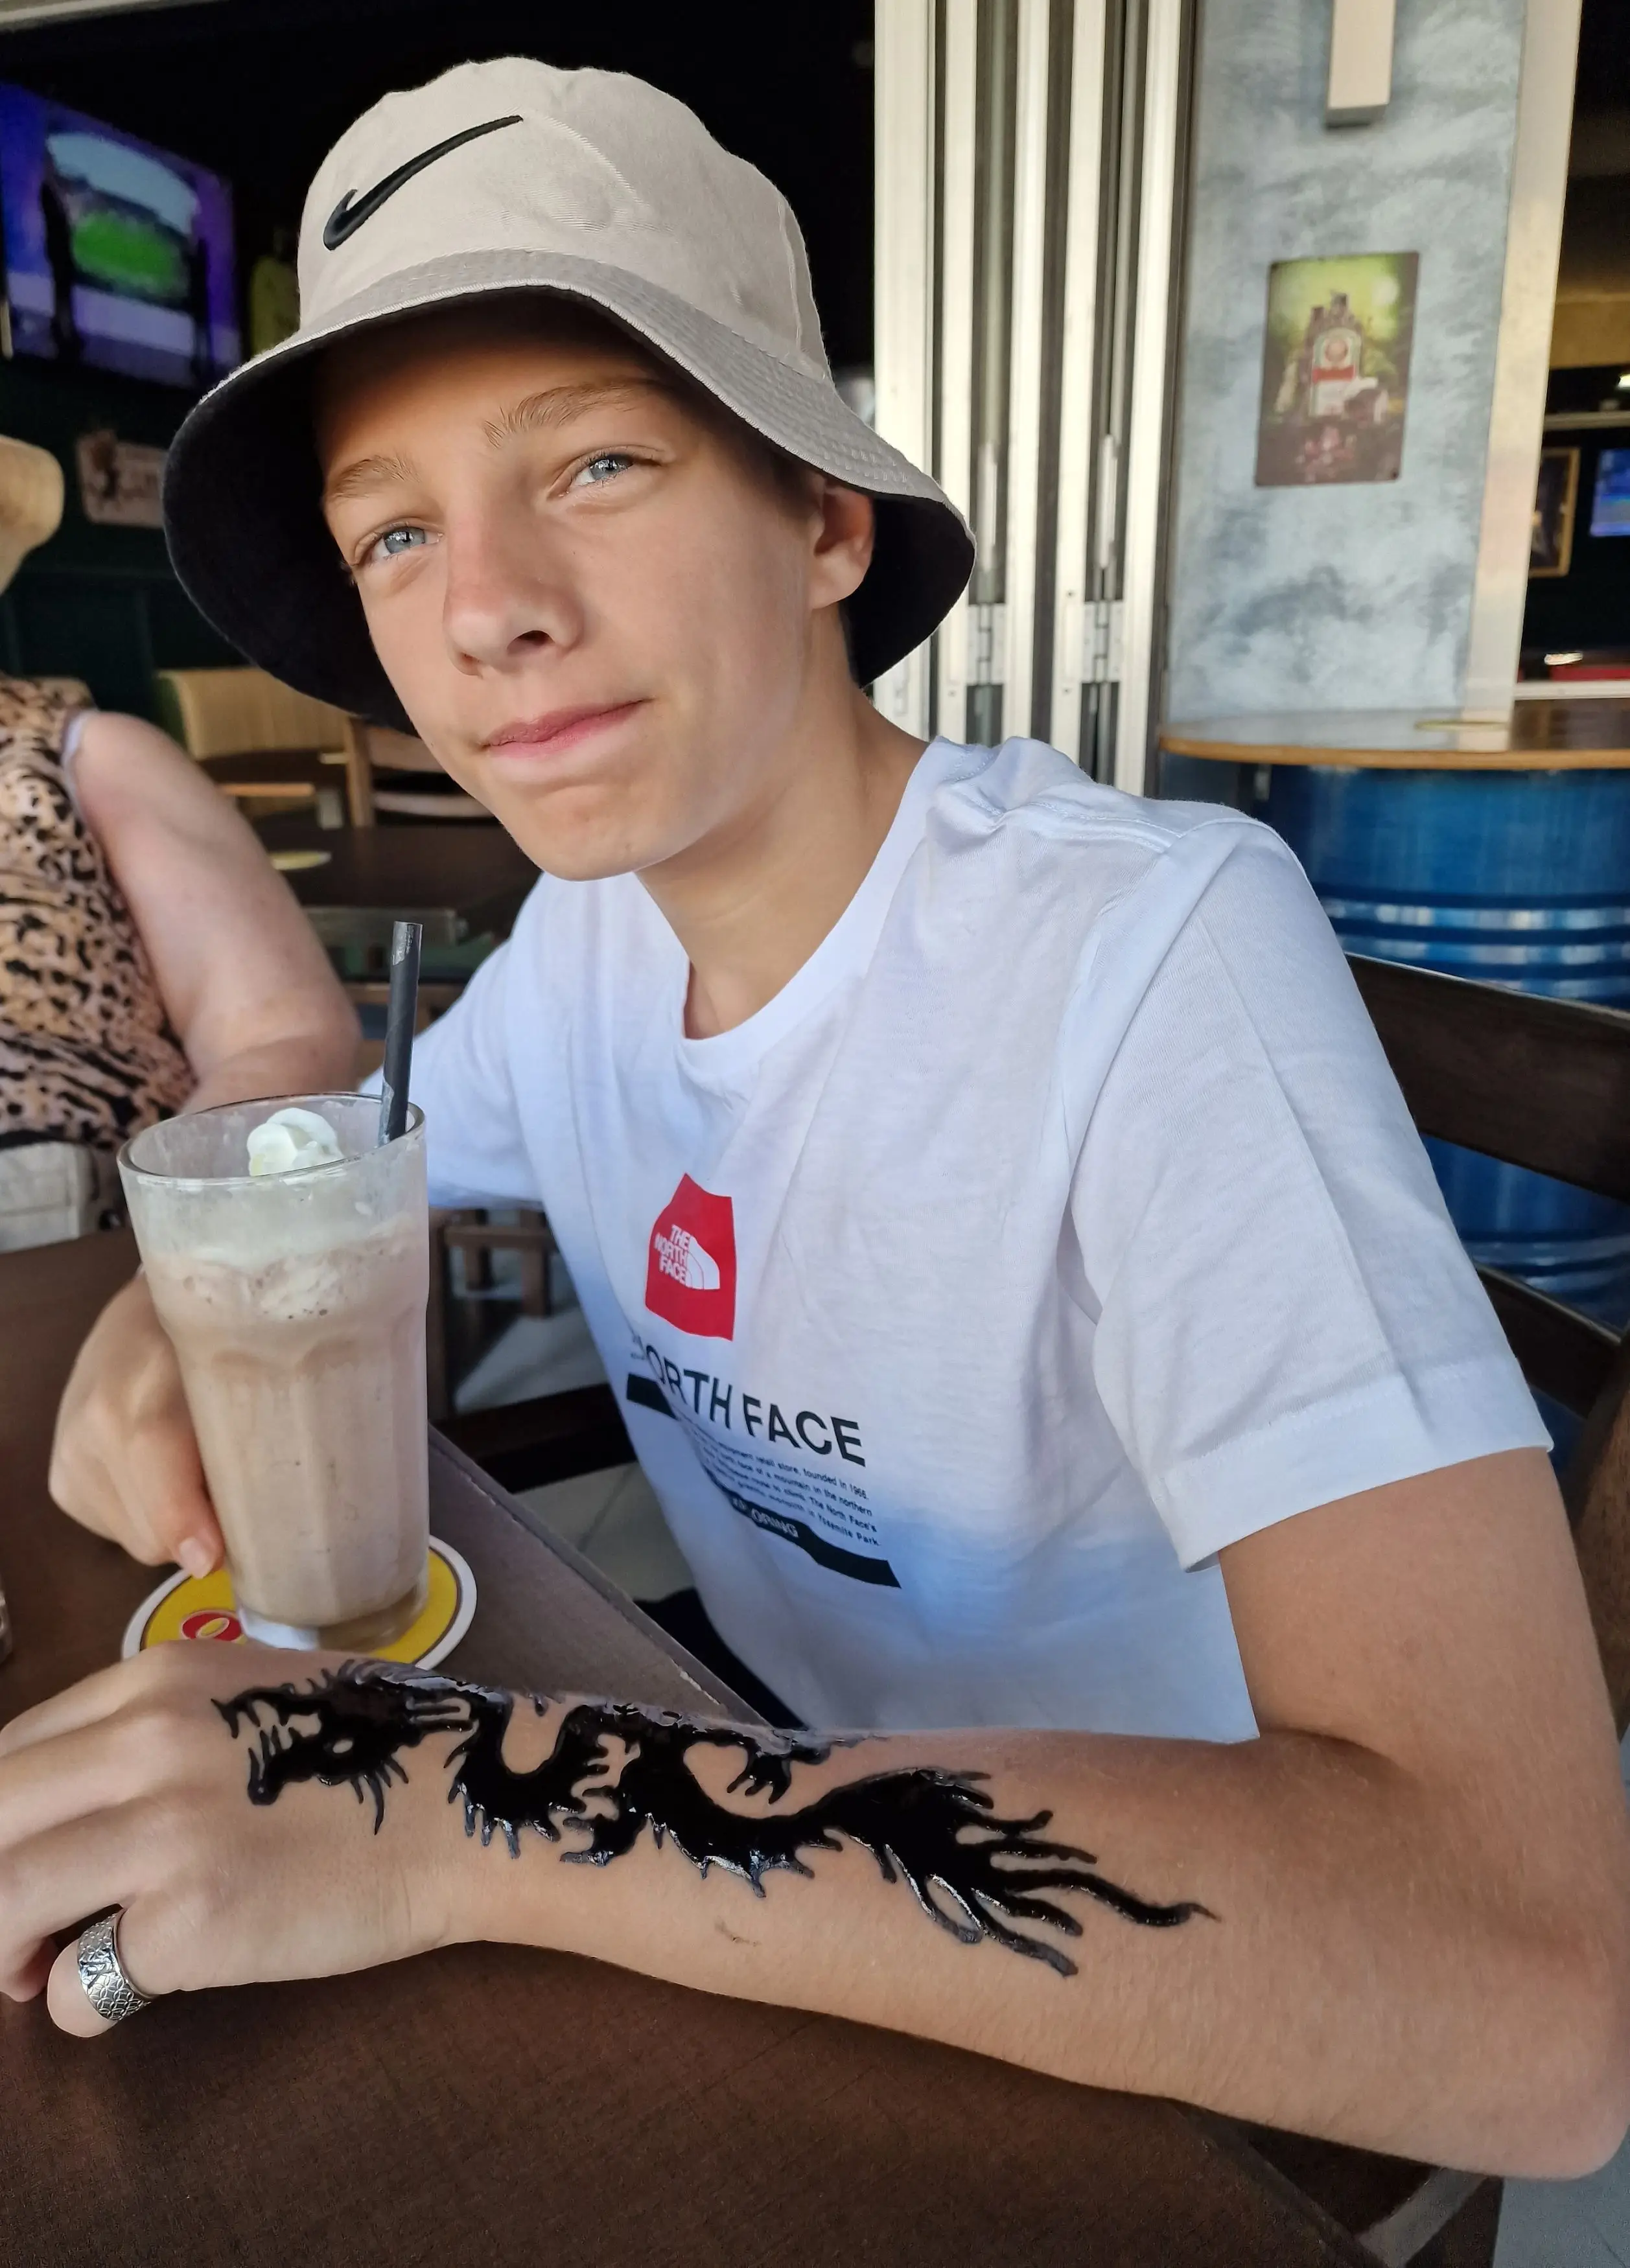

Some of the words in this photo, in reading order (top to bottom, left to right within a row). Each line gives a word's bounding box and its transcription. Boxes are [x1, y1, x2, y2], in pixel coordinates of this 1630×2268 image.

[654, 1232, 689, 1269] NORTH
[670, 1223, 690, 1251] THE
[659, 1253, 687, 1286] FACE
[743, 1393, 867, 1468] FACE
[803, 1468, 837, 1486] founded
[838, 1478, 847, 1491] in
[809, 1495, 825, 1510] The
[826, 1503, 846, 1522] North
[813, 1485, 822, 1496] in
[823, 1487, 837, 1501] the
[839, 1496, 873, 1517] northern
